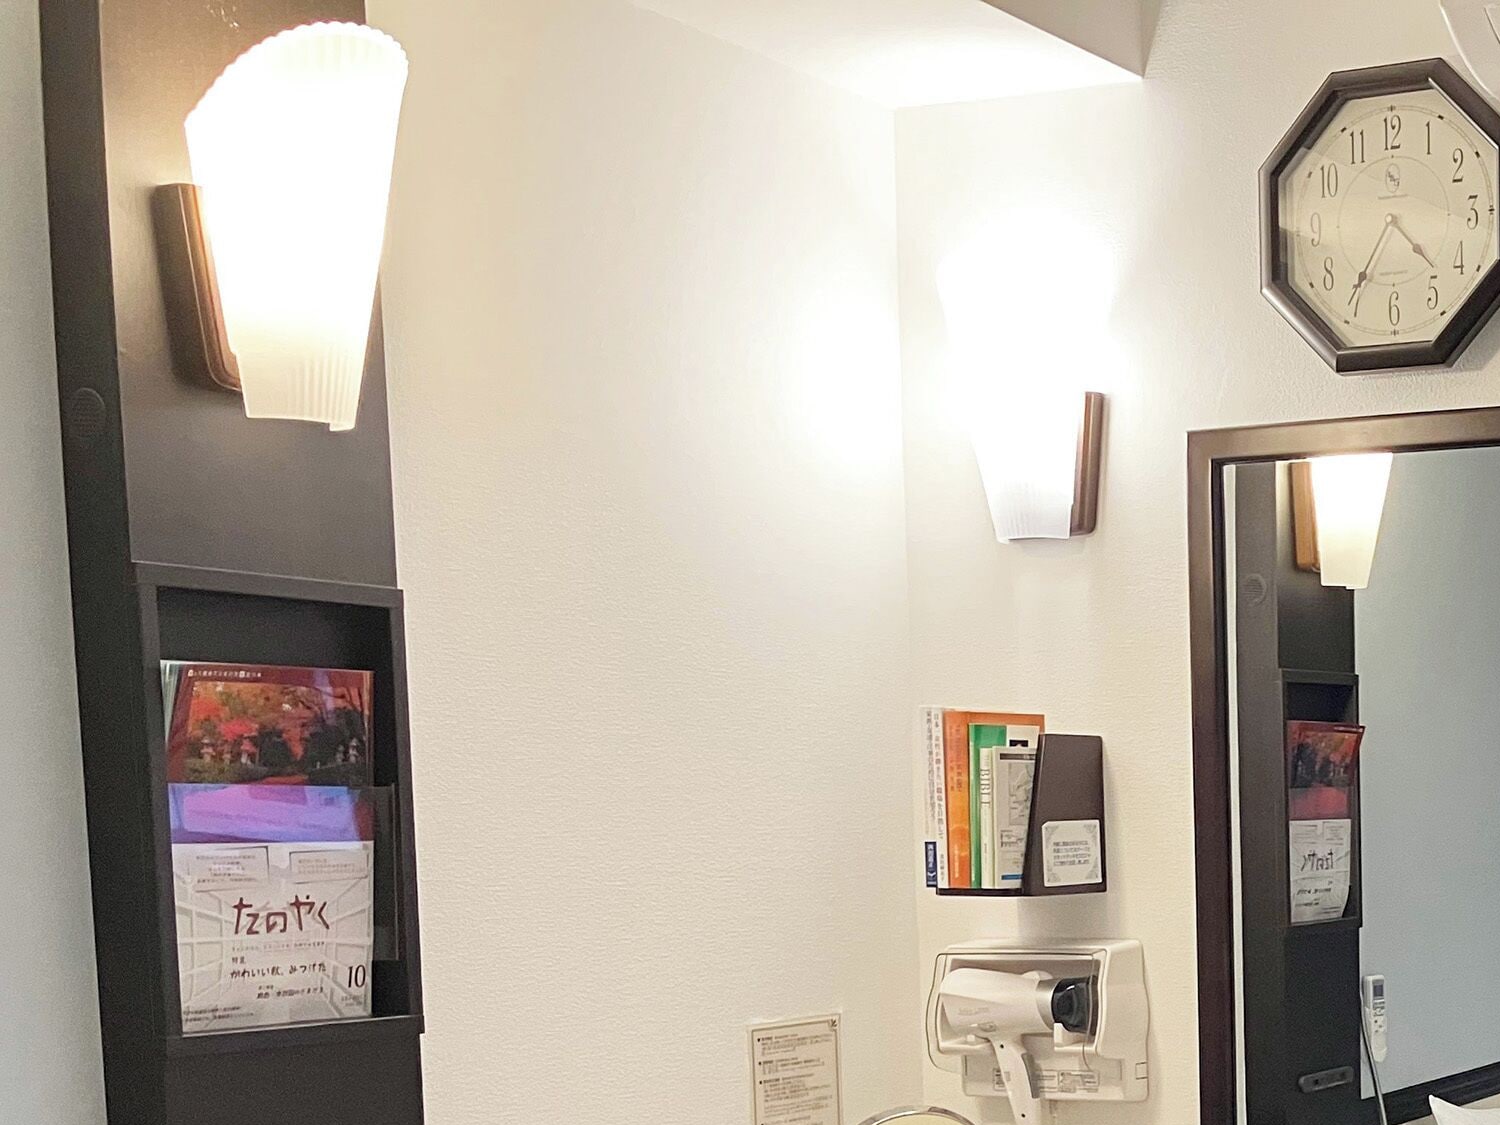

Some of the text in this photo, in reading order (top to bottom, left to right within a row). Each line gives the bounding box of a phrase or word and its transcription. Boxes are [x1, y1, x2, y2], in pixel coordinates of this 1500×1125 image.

[1350, 129, 1365, 165] 11
[1383, 115, 1401, 151] 12
[1426, 121, 1433, 155] 1
[1320, 163, 1339, 199] 10
[1452, 148, 1464, 184] 2
[1310, 212, 1322, 247] 9
[1466, 194, 1479, 230] 3
[1323, 256, 1335, 292] 8
[1453, 240, 1465, 275] 4
[1388, 290, 1400, 326] 6
[1426, 275, 1439, 310] 5
[347, 964, 367, 989] 10
